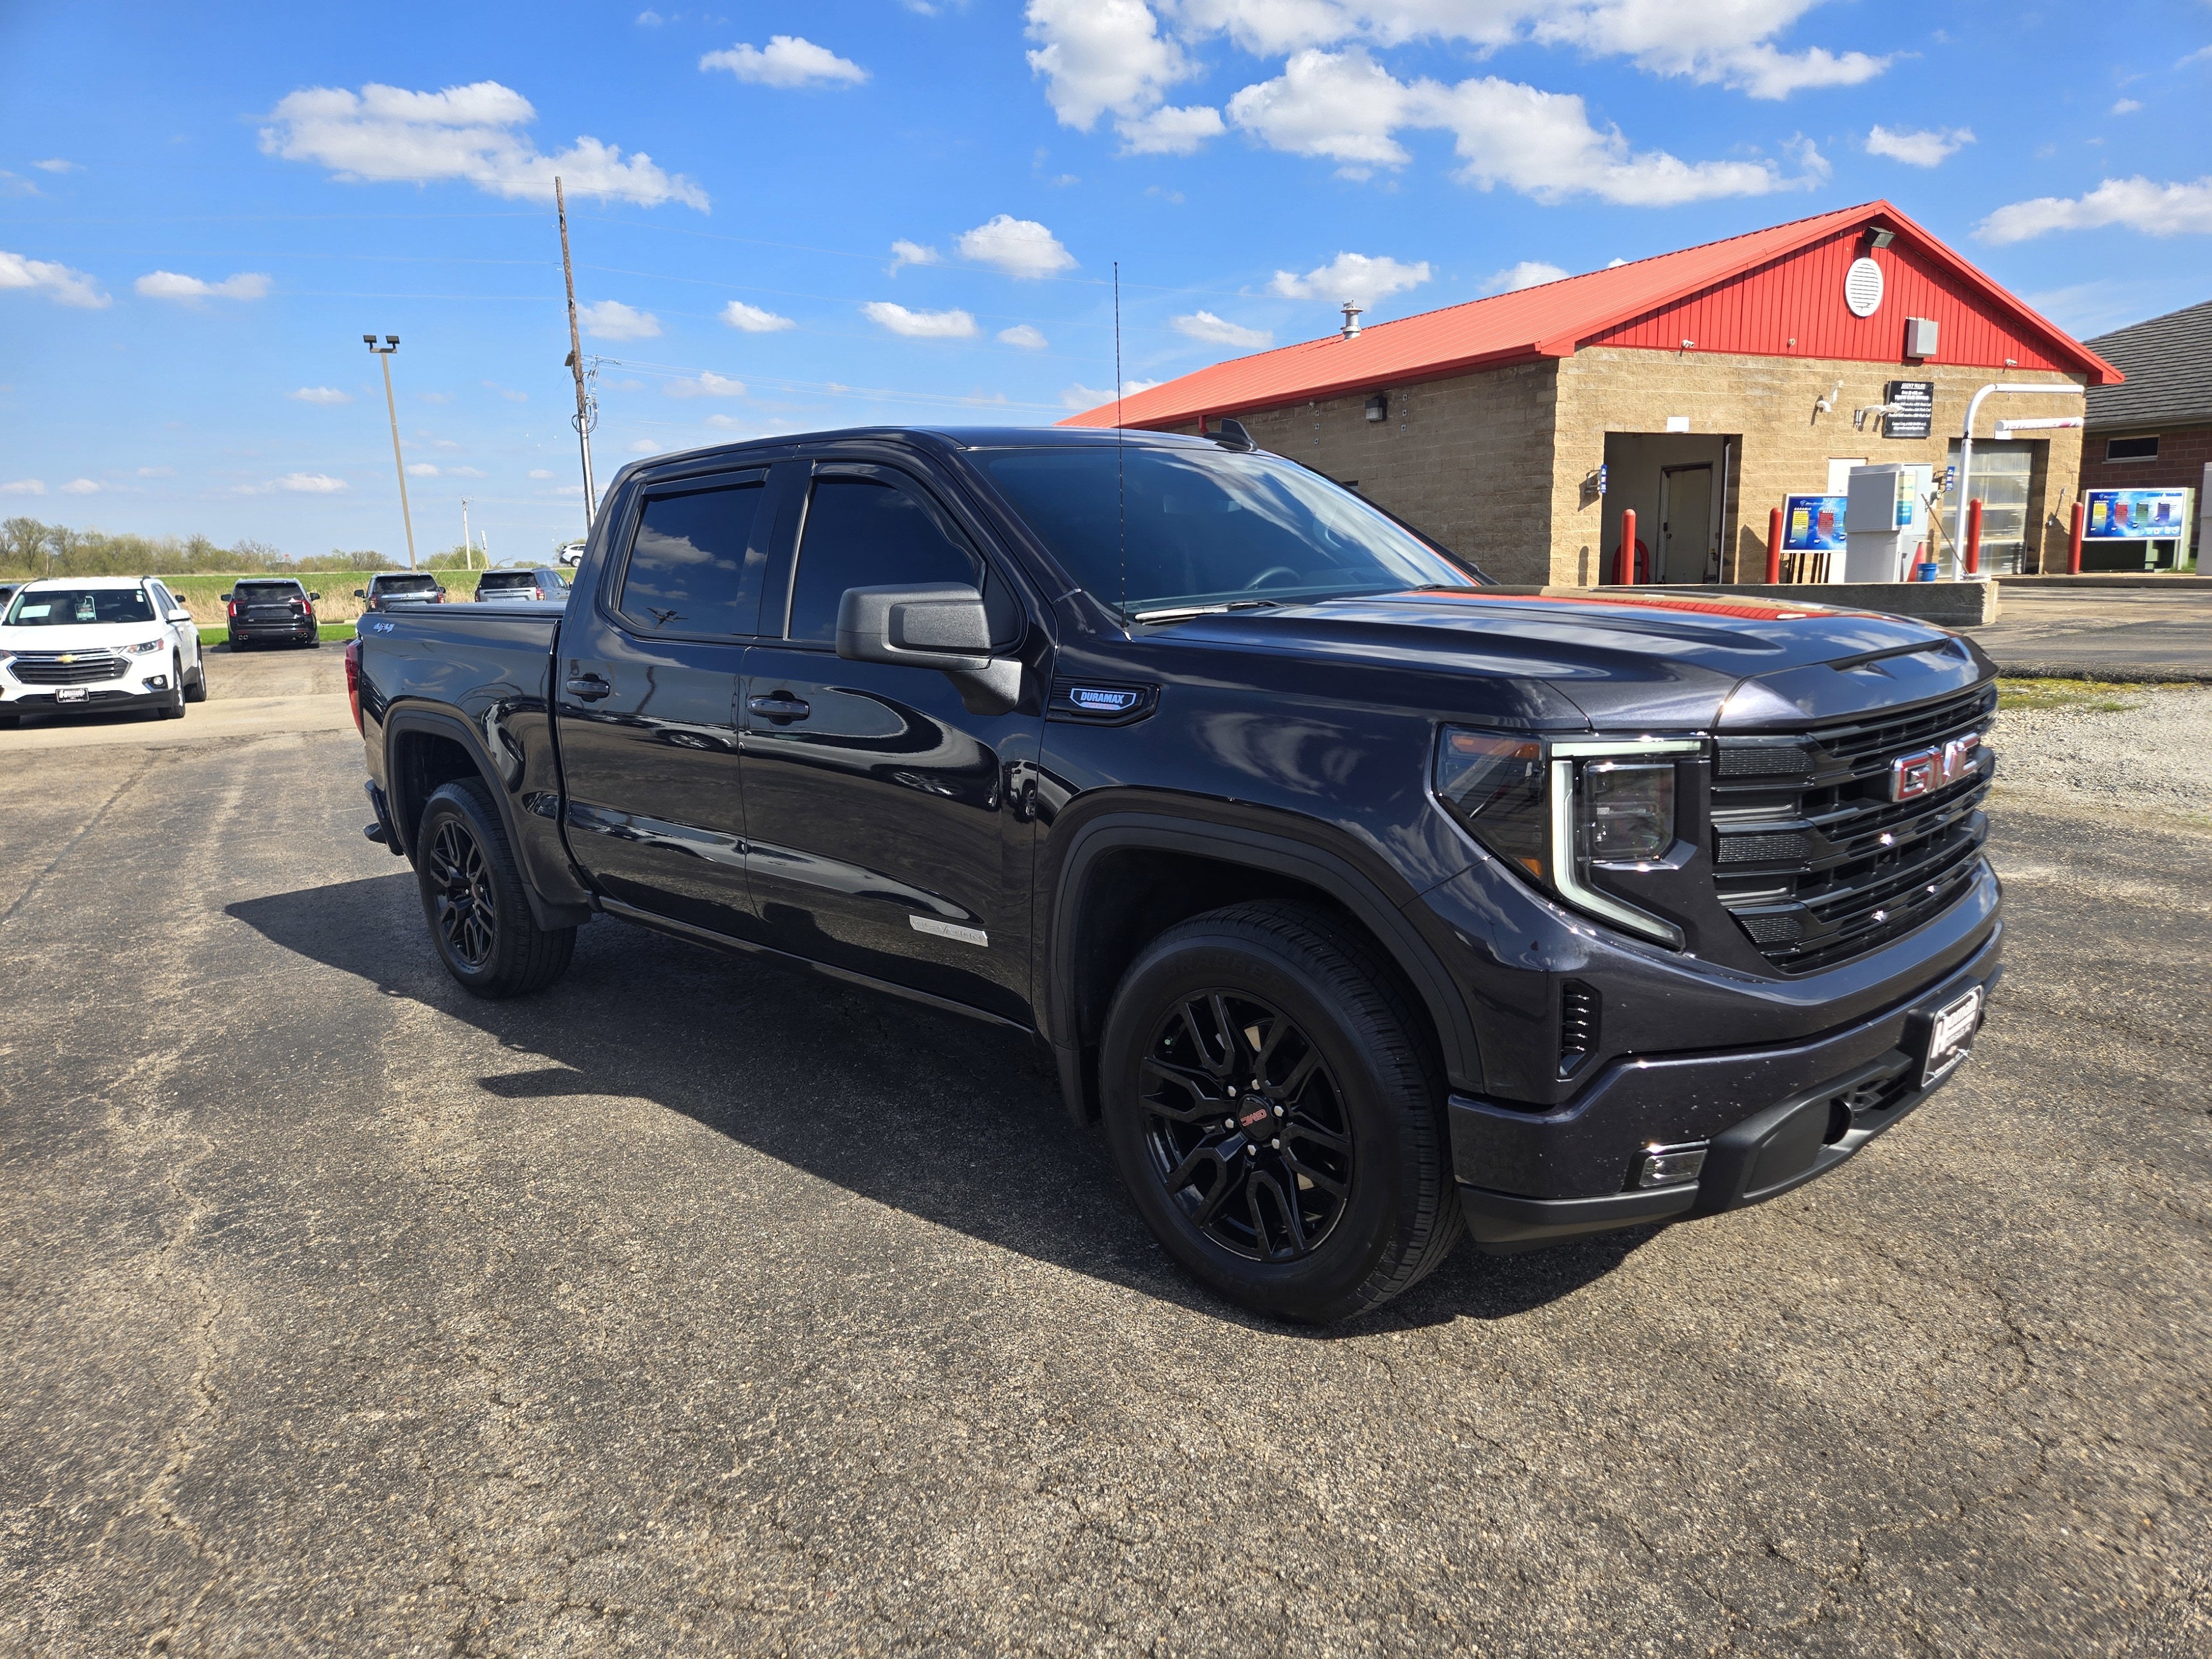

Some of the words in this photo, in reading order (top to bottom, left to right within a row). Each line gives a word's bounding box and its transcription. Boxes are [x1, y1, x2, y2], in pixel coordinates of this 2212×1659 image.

[1080, 691, 1124, 704] DURAMAX
[1891, 732, 1981, 803] GMC
[915, 920, 982, 942] ELEVATION
[1240, 1109, 1267, 1127] GMC
